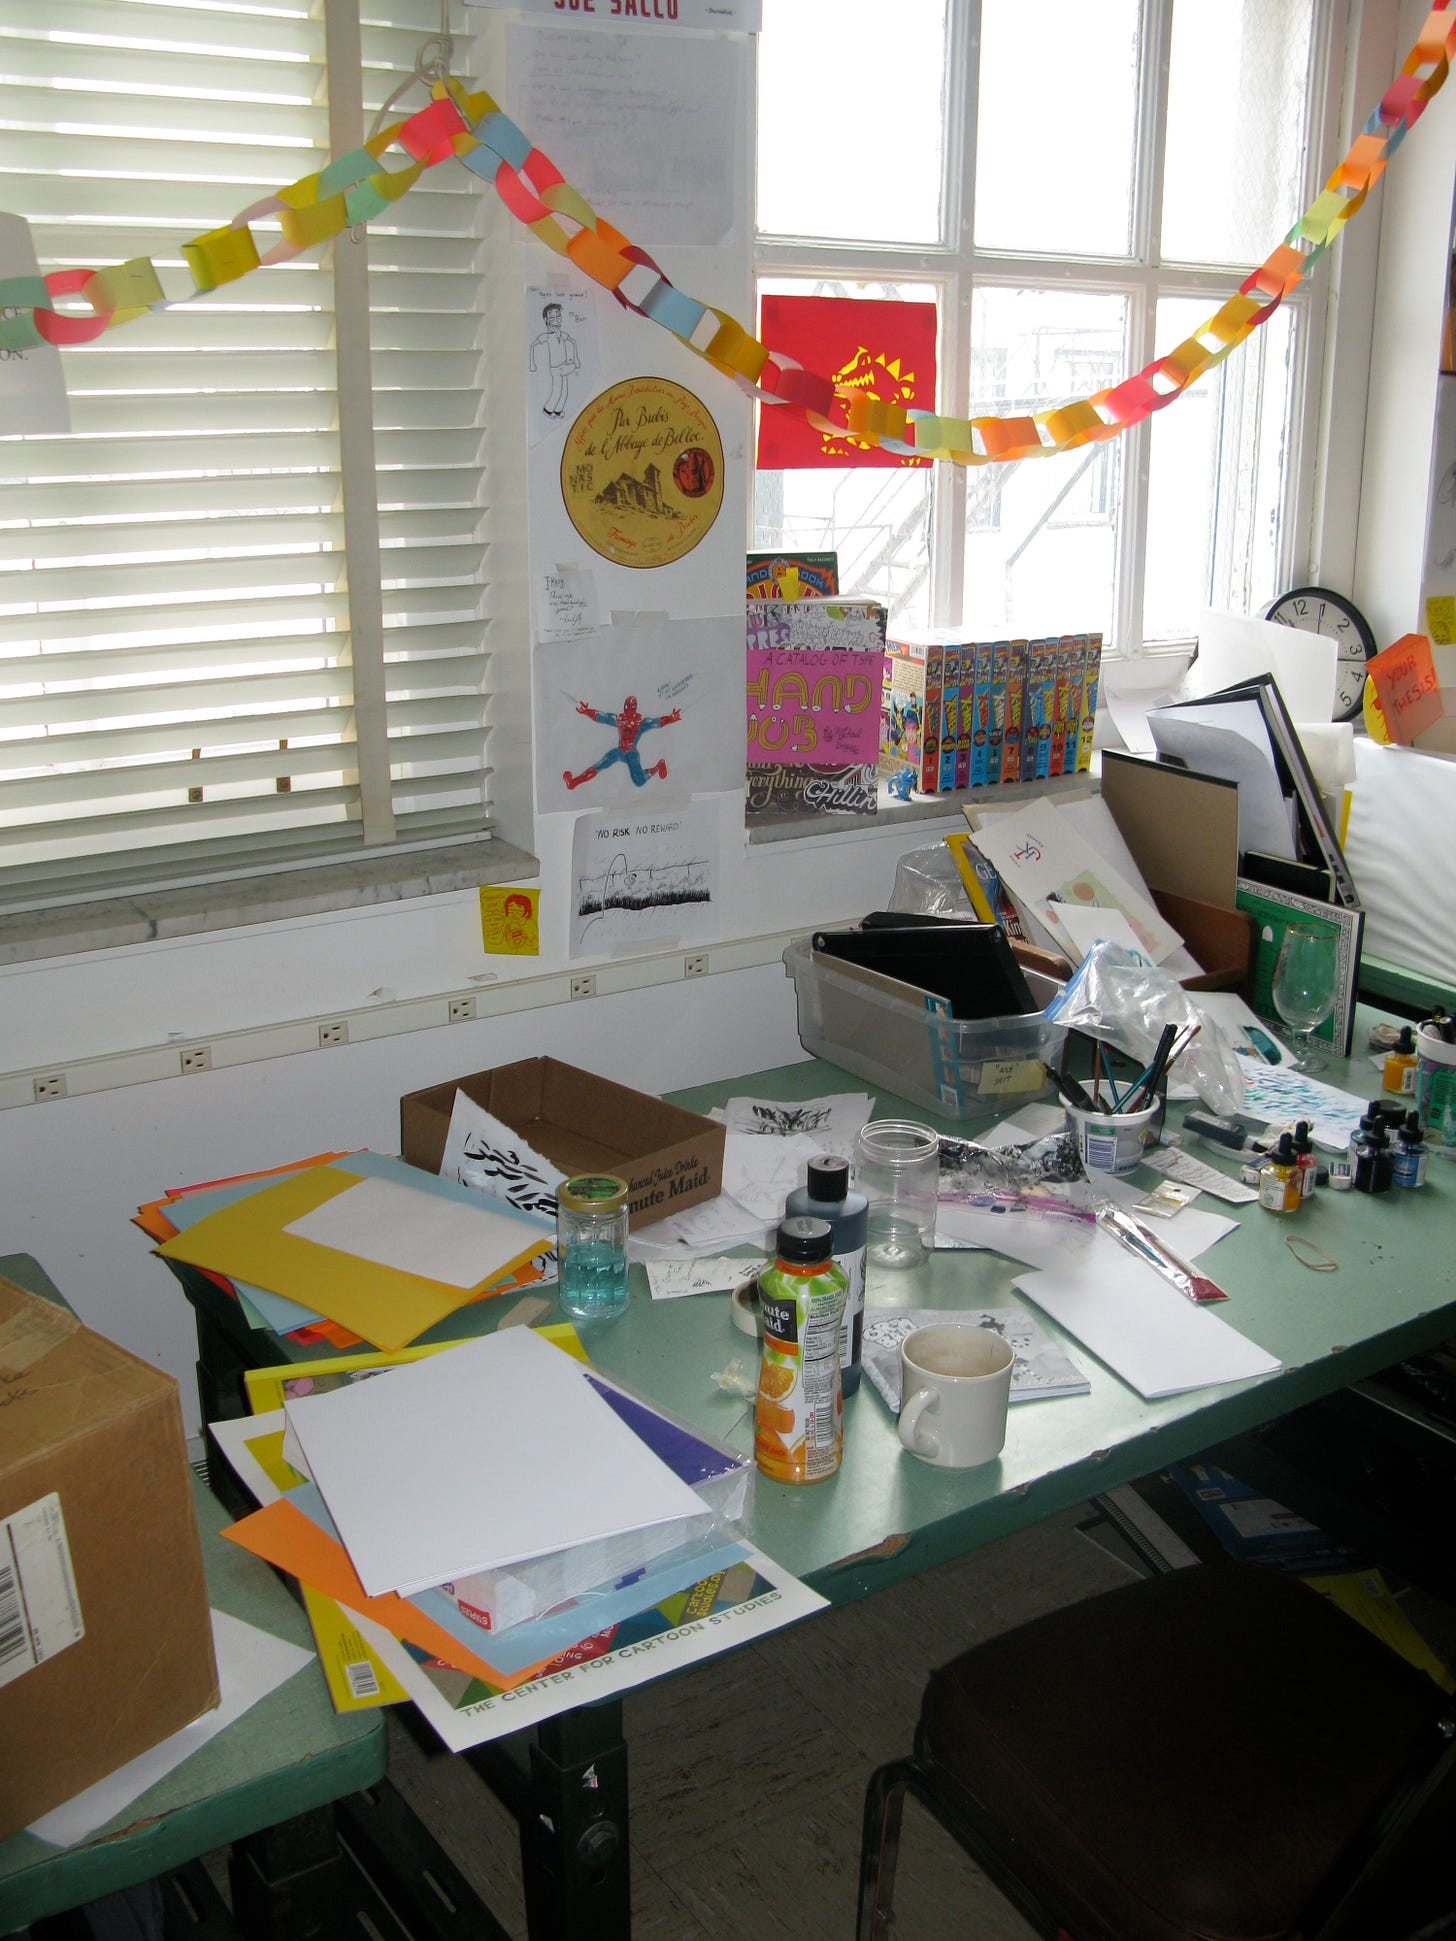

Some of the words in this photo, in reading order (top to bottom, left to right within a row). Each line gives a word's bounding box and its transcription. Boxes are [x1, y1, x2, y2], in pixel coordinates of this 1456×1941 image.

[1292, 599, 1309, 616] 12
[1337, 618, 1351, 633] 2
[1349, 644, 1363, 656] 3
[763, 652, 773, 665] A
[776, 652, 828, 666] CATALOG
[832, 654, 849, 665] OF
[852, 654, 875, 666] TYPE
[1350, 670, 1364, 683] 4
[1386, 654, 1418, 690] YOUR
[747, 667, 872, 715] HAND
[1339, 691, 1352, 708] 5
[1392, 666, 1438, 716] THESIS!
[612, 828, 631, 839] RISK
[635, 826, 648, 835] NO
[654, 1167, 674, 1187] Juice
[674, 1155, 699, 1177] Drinks
[668, 1166, 709, 1199] Maid
[459, 1698, 496, 1718] THE
[501, 1671, 576, 1703] CENTER
[579, 1655, 615, 1674] FOR
[618, 1622, 705, 1660] CARTOON
[709, 1591, 783, 1626] STUDIES
